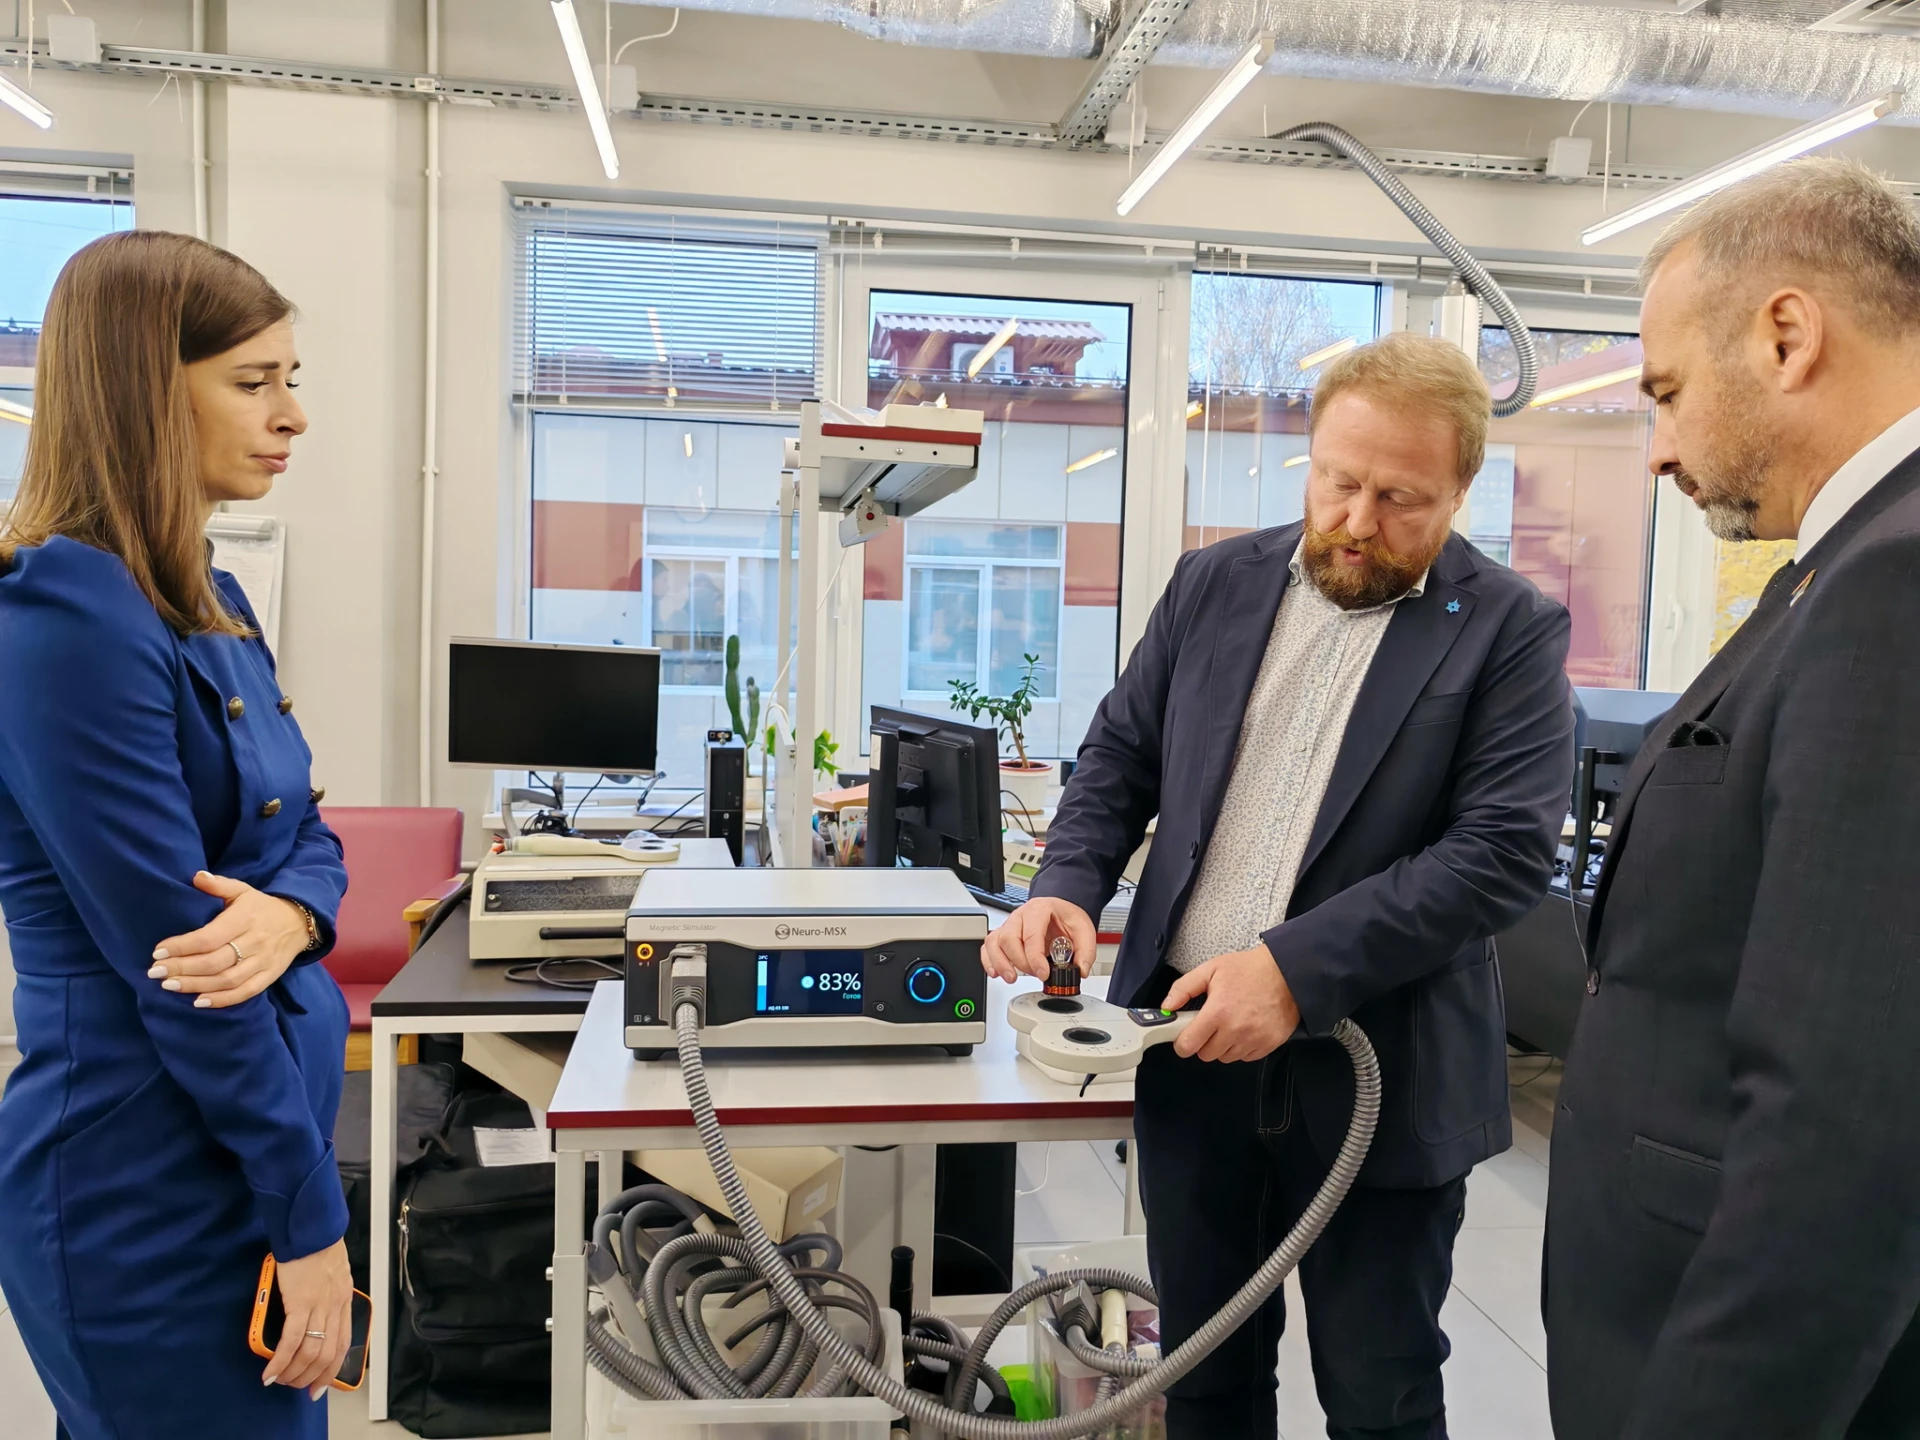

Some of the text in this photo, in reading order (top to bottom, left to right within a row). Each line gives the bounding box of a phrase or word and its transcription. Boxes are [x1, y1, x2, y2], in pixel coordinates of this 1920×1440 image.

[649, 924, 680, 932] Magnetic
[791, 926, 847, 936] Neuro-MSX
[819, 973, 861, 991] 83%
